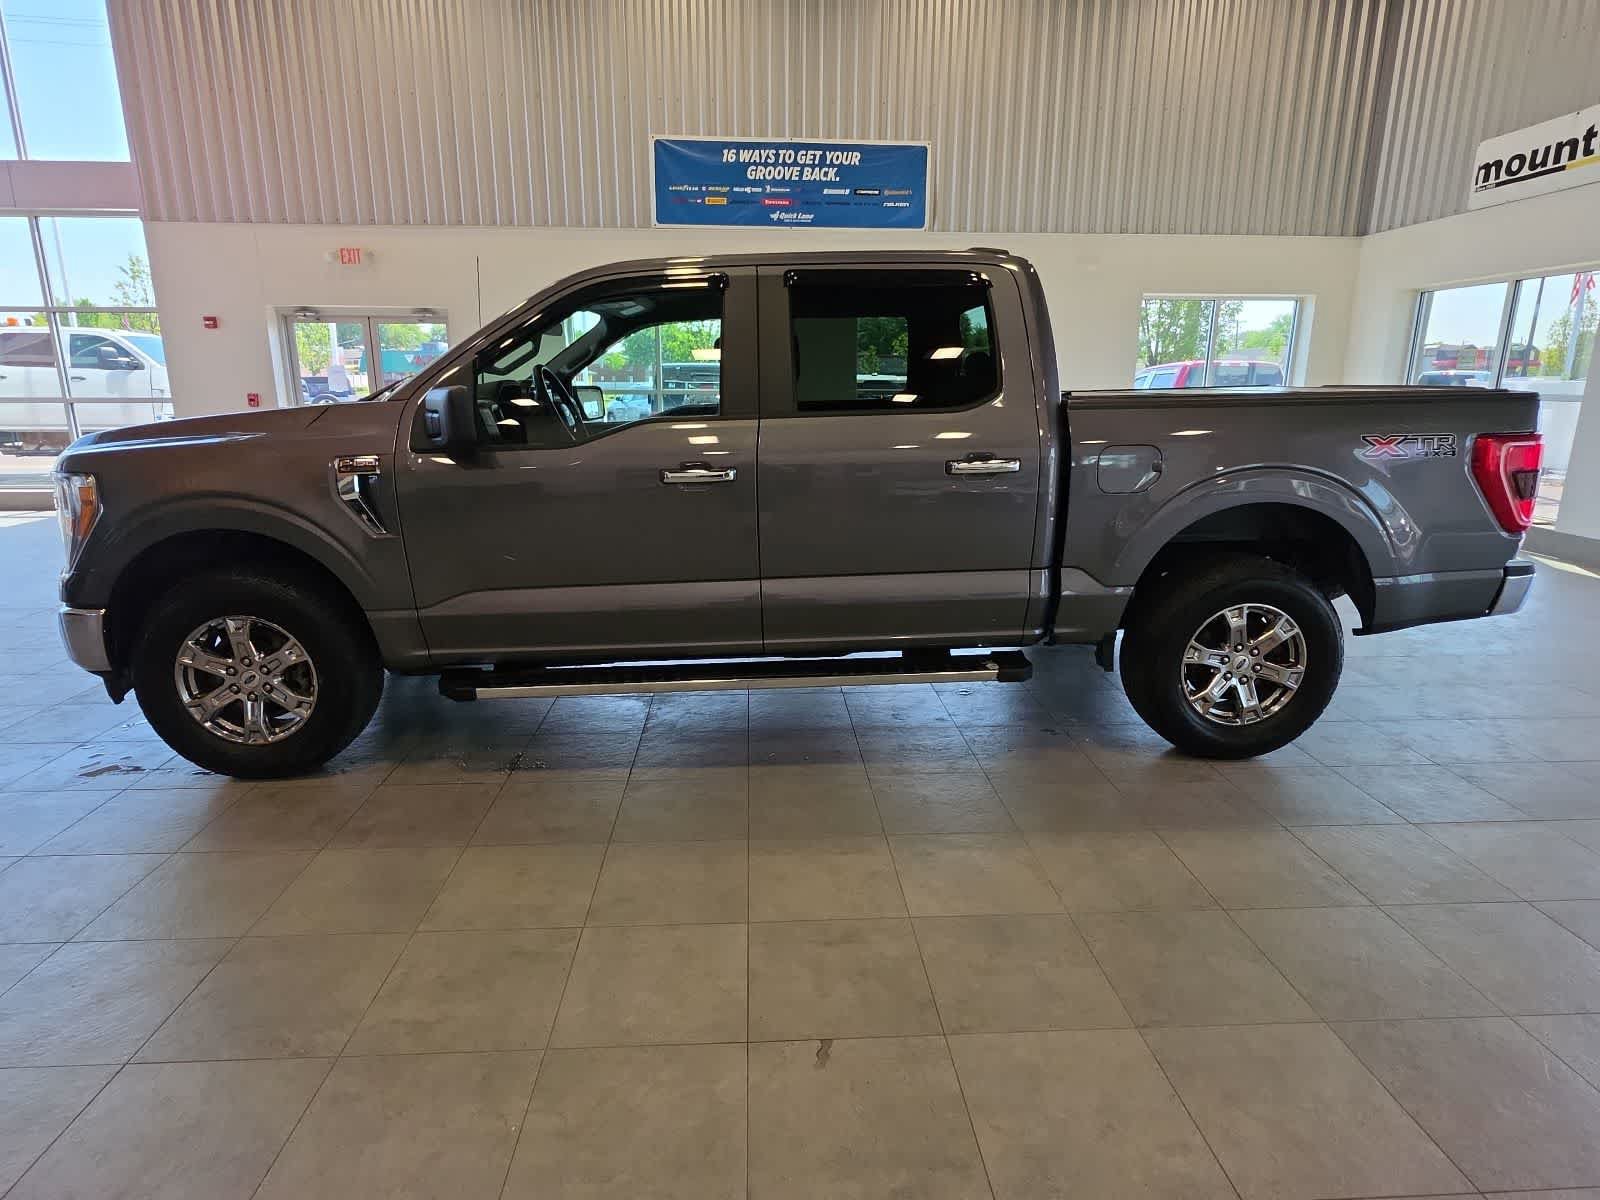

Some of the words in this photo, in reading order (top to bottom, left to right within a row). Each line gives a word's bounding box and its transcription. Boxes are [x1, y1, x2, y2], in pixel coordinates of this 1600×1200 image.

[722, 149, 737, 163] 16
[739, 149, 776, 164] WAYS
[778, 150, 795, 164] TO
[796, 150, 823, 165] GET
[825, 151, 861, 166] YOUR
[1474, 123, 1599, 186] mount
[746, 166, 800, 180] GROOVE
[802, 167, 840, 182] BACK.
[779, 212, 797, 220] Quick
[340, 248, 360, 264] EXIT
